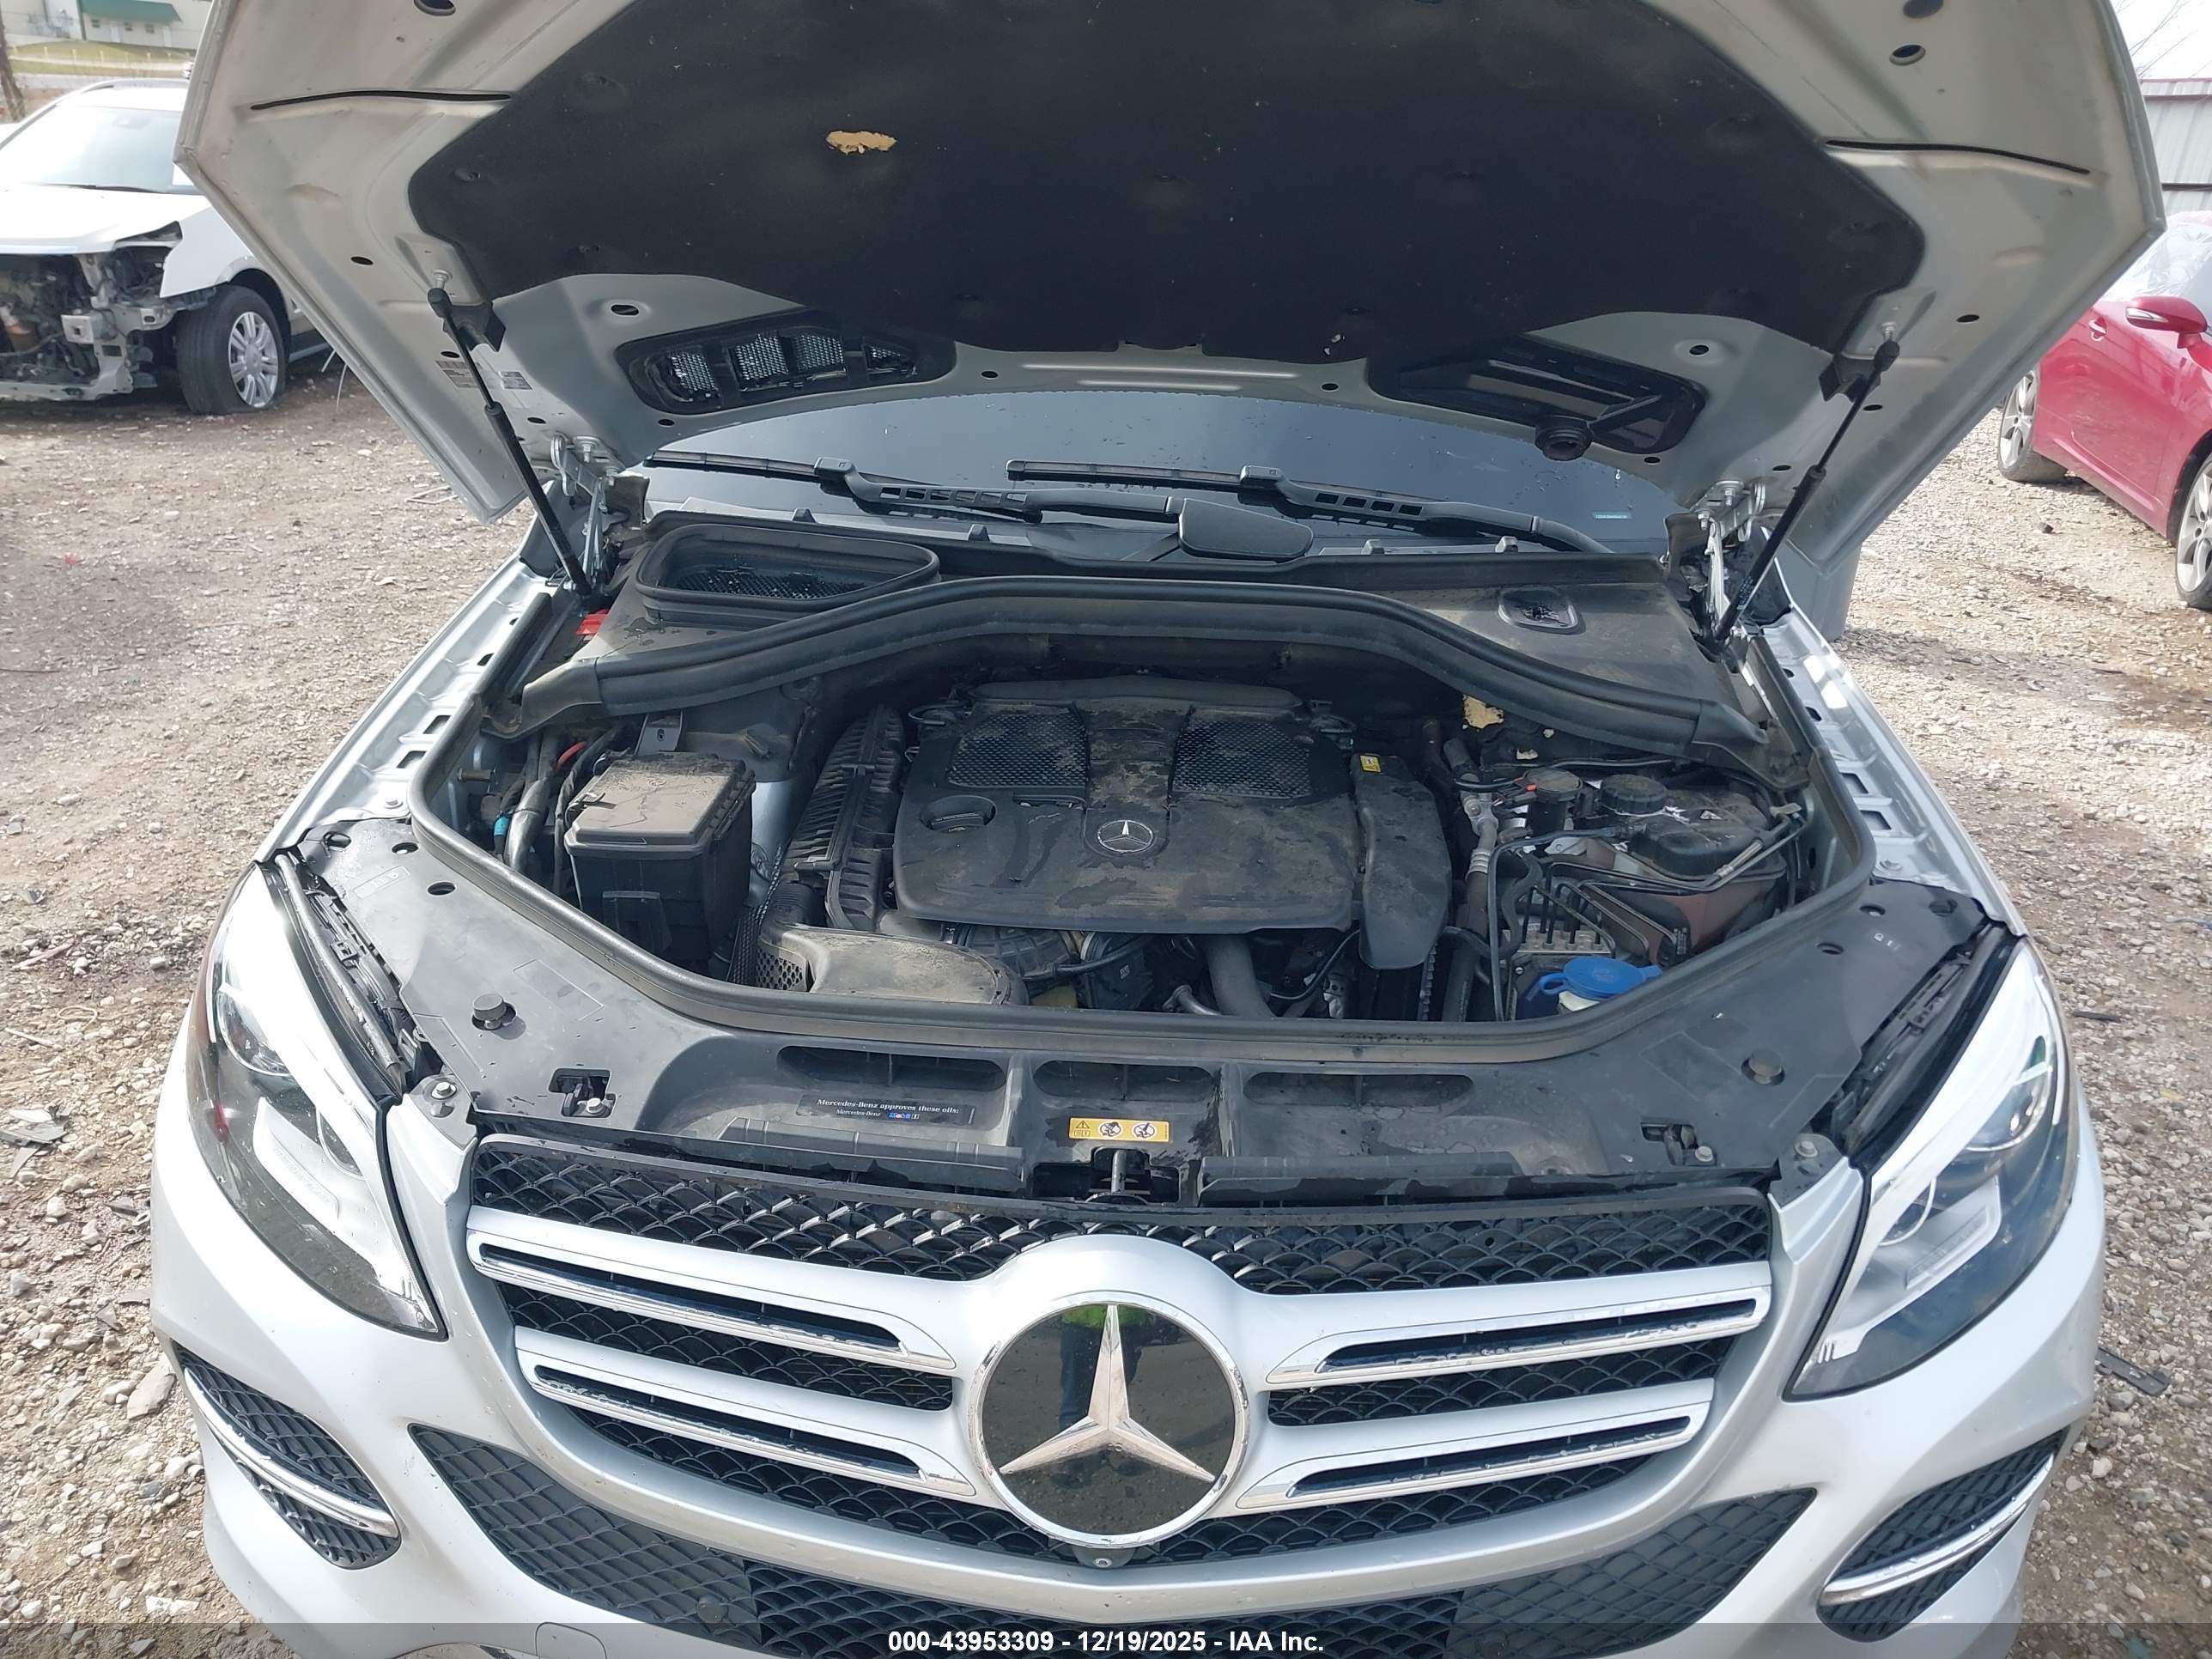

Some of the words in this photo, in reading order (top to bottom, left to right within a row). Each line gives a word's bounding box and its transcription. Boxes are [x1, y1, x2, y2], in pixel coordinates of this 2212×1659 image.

[817, 1098, 878, 1109] Mercedes-Benz
[879, 1103, 916, 1112] approves
[918, 1104, 941, 1114] these
[941, 1106, 960, 1115] oils:
[836, 1108, 881, 1118] Mercedes-Benz
